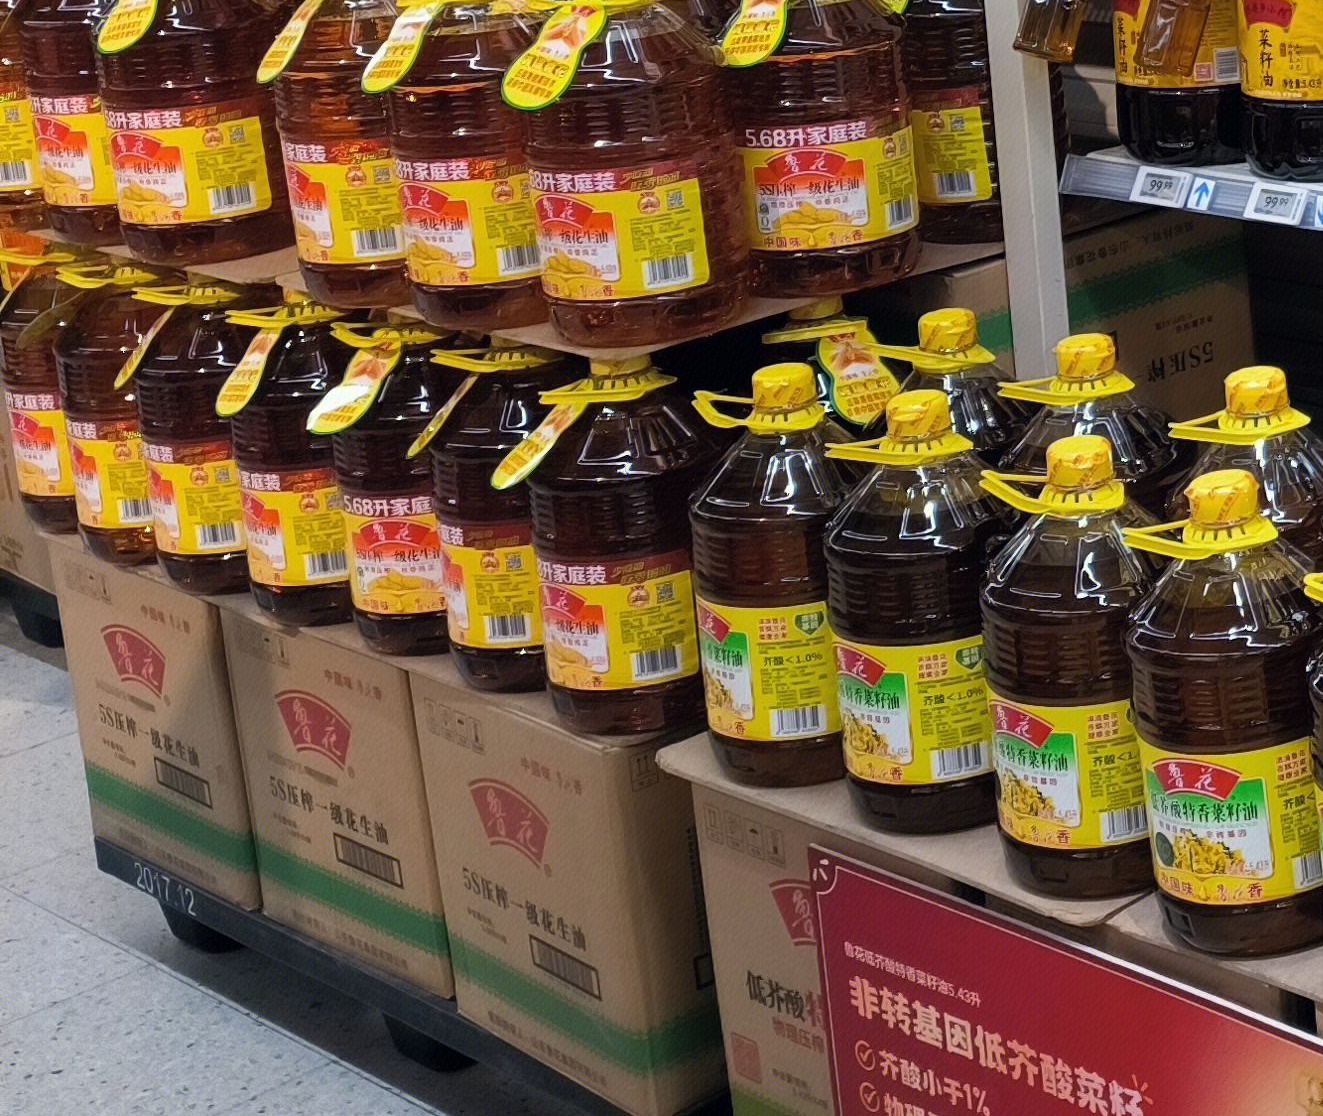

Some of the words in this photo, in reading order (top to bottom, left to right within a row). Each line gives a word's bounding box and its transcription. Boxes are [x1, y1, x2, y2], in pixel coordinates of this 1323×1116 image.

[1259, 29, 1274, 88] 菜籽油
[745, 122, 867, 148] 5.68升家庭装
[784, 152, 837, 173] 鲁花
[1167, 765, 1223, 792] 鲁花
[135, 862, 197, 917] 2017.12
